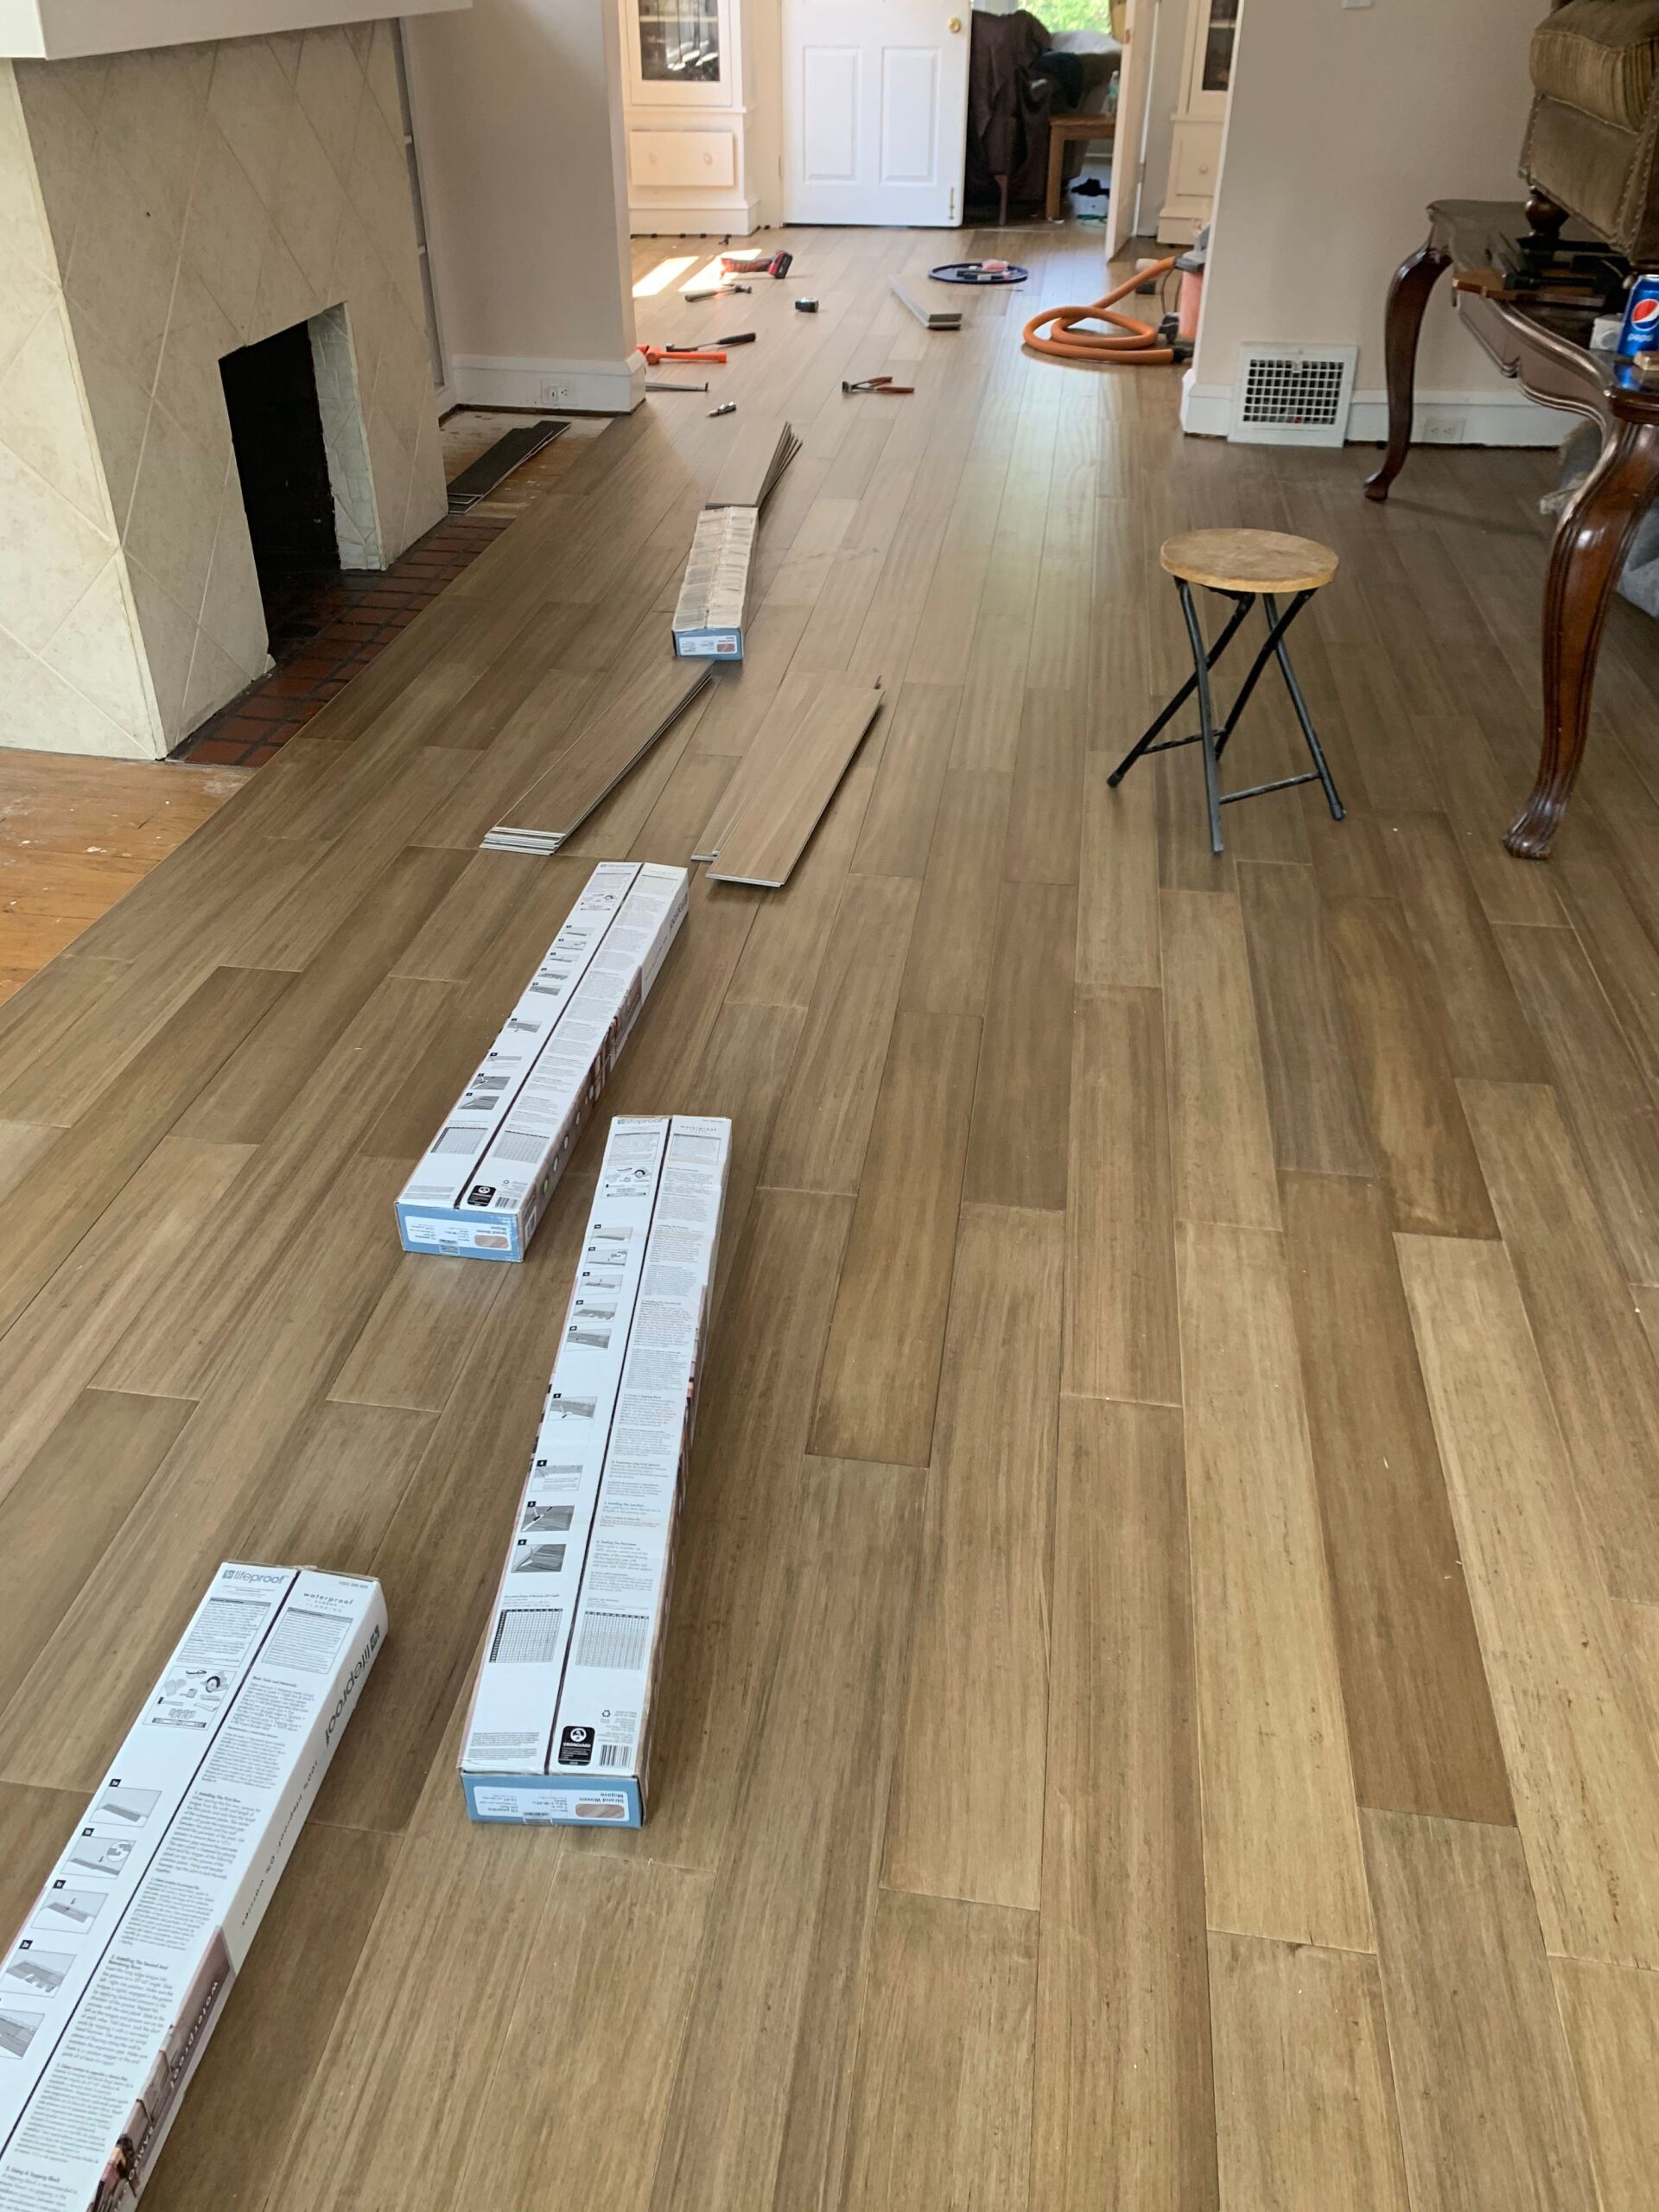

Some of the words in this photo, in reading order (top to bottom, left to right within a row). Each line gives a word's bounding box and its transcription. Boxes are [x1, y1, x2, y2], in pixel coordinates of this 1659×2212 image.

[233, 1569, 286, 1585] lifeproof
[303, 1592, 354, 1605] waterproof
[325, 1643, 372, 1748] lifeproof
